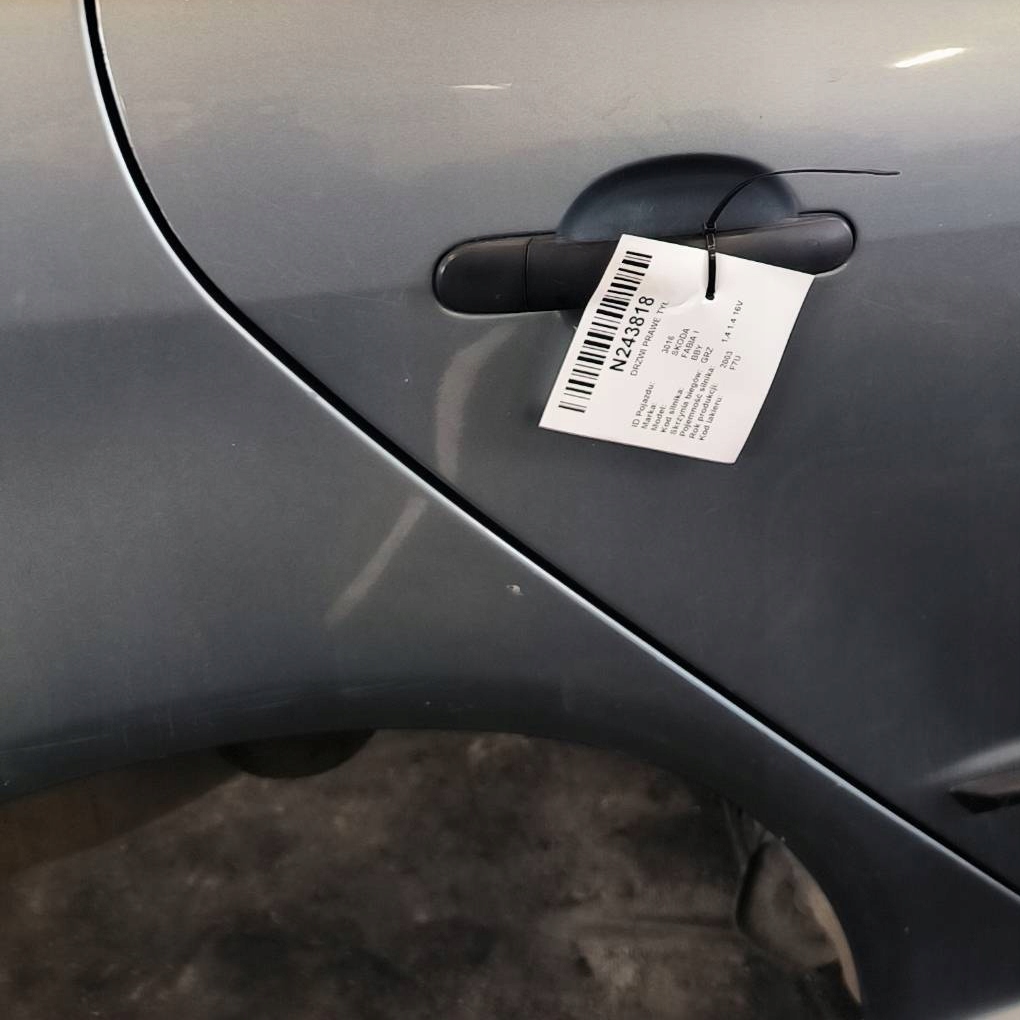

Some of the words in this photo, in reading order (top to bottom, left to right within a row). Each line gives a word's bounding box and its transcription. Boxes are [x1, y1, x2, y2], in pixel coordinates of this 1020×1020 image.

[609, 296, 654, 372] N243818
[671, 328, 690, 356] SKODA
[630, 348, 647, 376] DRZWI
[643, 318, 661, 347] PRAWE
[681, 336, 697, 359] FABIA
[631, 418, 640, 428] ID
[661, 417, 672, 433] Kod
[688, 424, 700, 439] Rok
[699, 425, 710, 440] Kod
